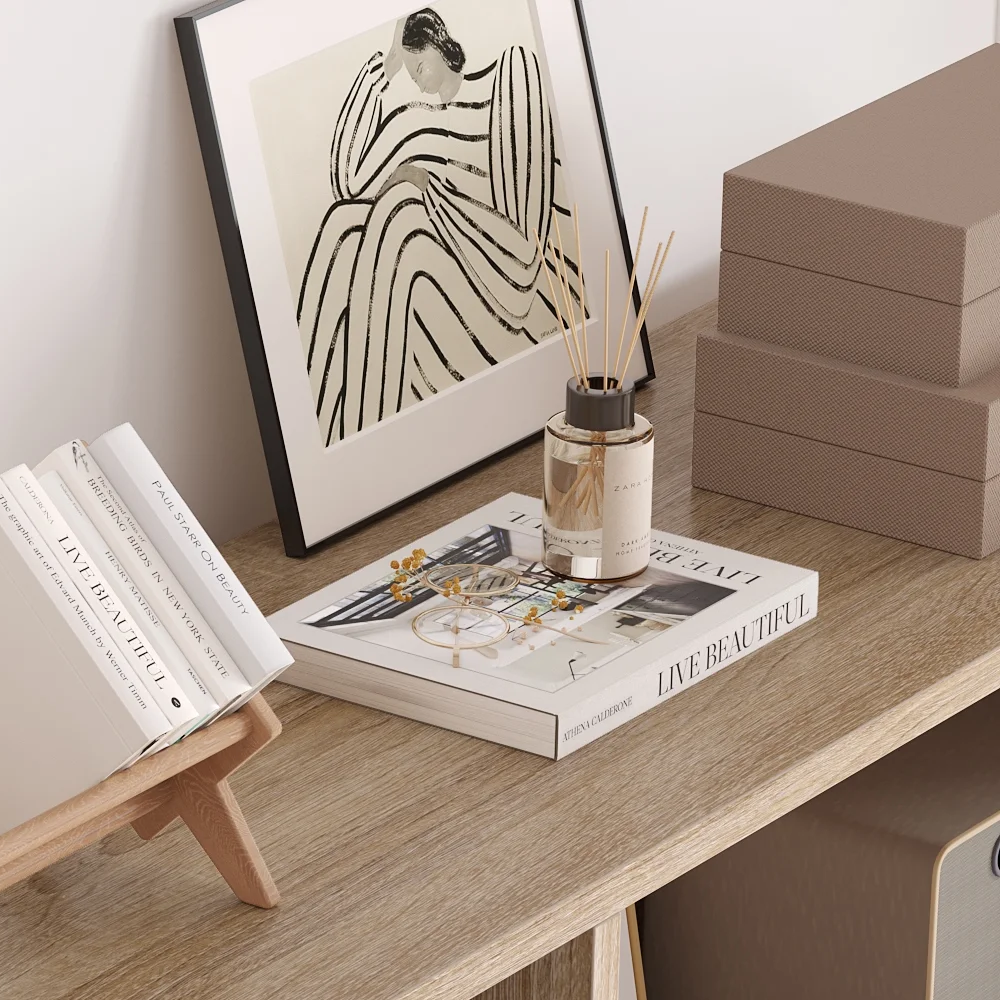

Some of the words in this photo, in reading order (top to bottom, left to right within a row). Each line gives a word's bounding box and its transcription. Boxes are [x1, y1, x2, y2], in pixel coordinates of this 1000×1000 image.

[98, 476, 108, 488] The
[613, 483, 641, 492] ZARA
[88, 478, 128, 532] BREEDING
[127, 535, 152, 568] BIRDS
[151, 571, 164, 583] IN
[162, 587, 184, 611] NEW
[181, 612, 205, 644] YORK
[204, 646, 230, 679] STATE
[152, 480, 175, 512] PAUL
[174, 512, 202, 548] STARR
[201, 550, 218, 572] ON
[216, 573, 249, 616] BEAUTY
[682, 557, 762, 585] LIVE
[8, 514, 34, 546] graphic
[33, 546, 44, 559] art
[43, 561, 54, 571] of
[51, 572, 75, 604] Edvard
[73, 604, 97, 636] Munch
[95, 636, 106, 648] by
[106, 650, 129, 681] Werner
[128, 682, 148, 709] Timm
[58, 535, 95, 582] LIVE
[91, 582, 167, 690] BEAUTIFUL
[105, 551, 130, 583] HENRY
[129, 586, 161, 628] MATISSE
[187, 668, 207, 695] TASCHEN
[657, 651, 701, 698] LIVE
[705, 592, 811, 671] BEAUTIFUL
[562, 720, 590, 743] ATHENA
[591, 696, 633, 726] CALDERONE
